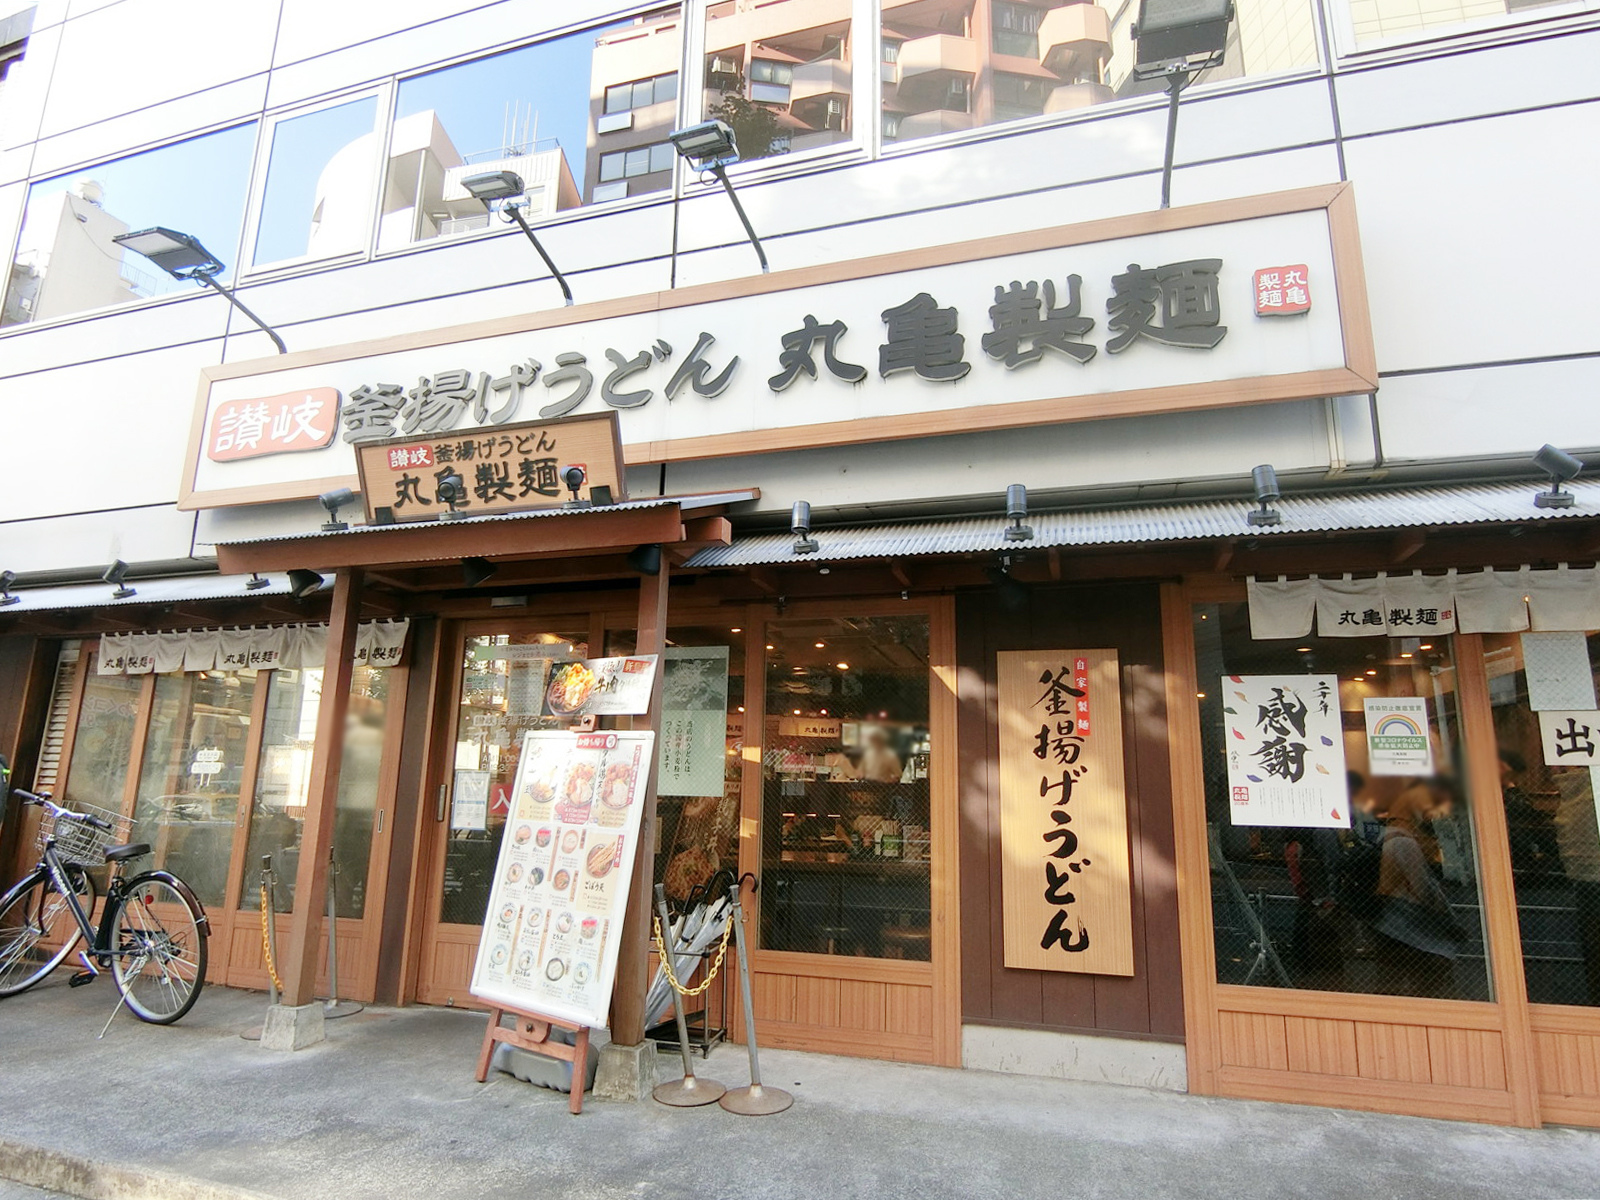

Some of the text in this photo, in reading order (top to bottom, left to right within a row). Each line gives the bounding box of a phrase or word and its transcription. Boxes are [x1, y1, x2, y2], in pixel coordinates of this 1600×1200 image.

[214, 257, 1229, 454] 讃岐 釜揚げうどん 丸亀製麺
[390, 430, 557, 468] 讃岐 釜揚げうどん
[1337, 607, 1438, 627] 丸亀製麺
[103, 655, 149, 669] 丸亀製麺
[223, 651, 274, 664] 丸亀製麺
[353, 646, 397, 660] 亀製麺
[1248, 686, 1314, 784] 感謝
[1555, 717, 1600, 758] 出
[1030, 666, 1092, 953] 釜揚げうどん
